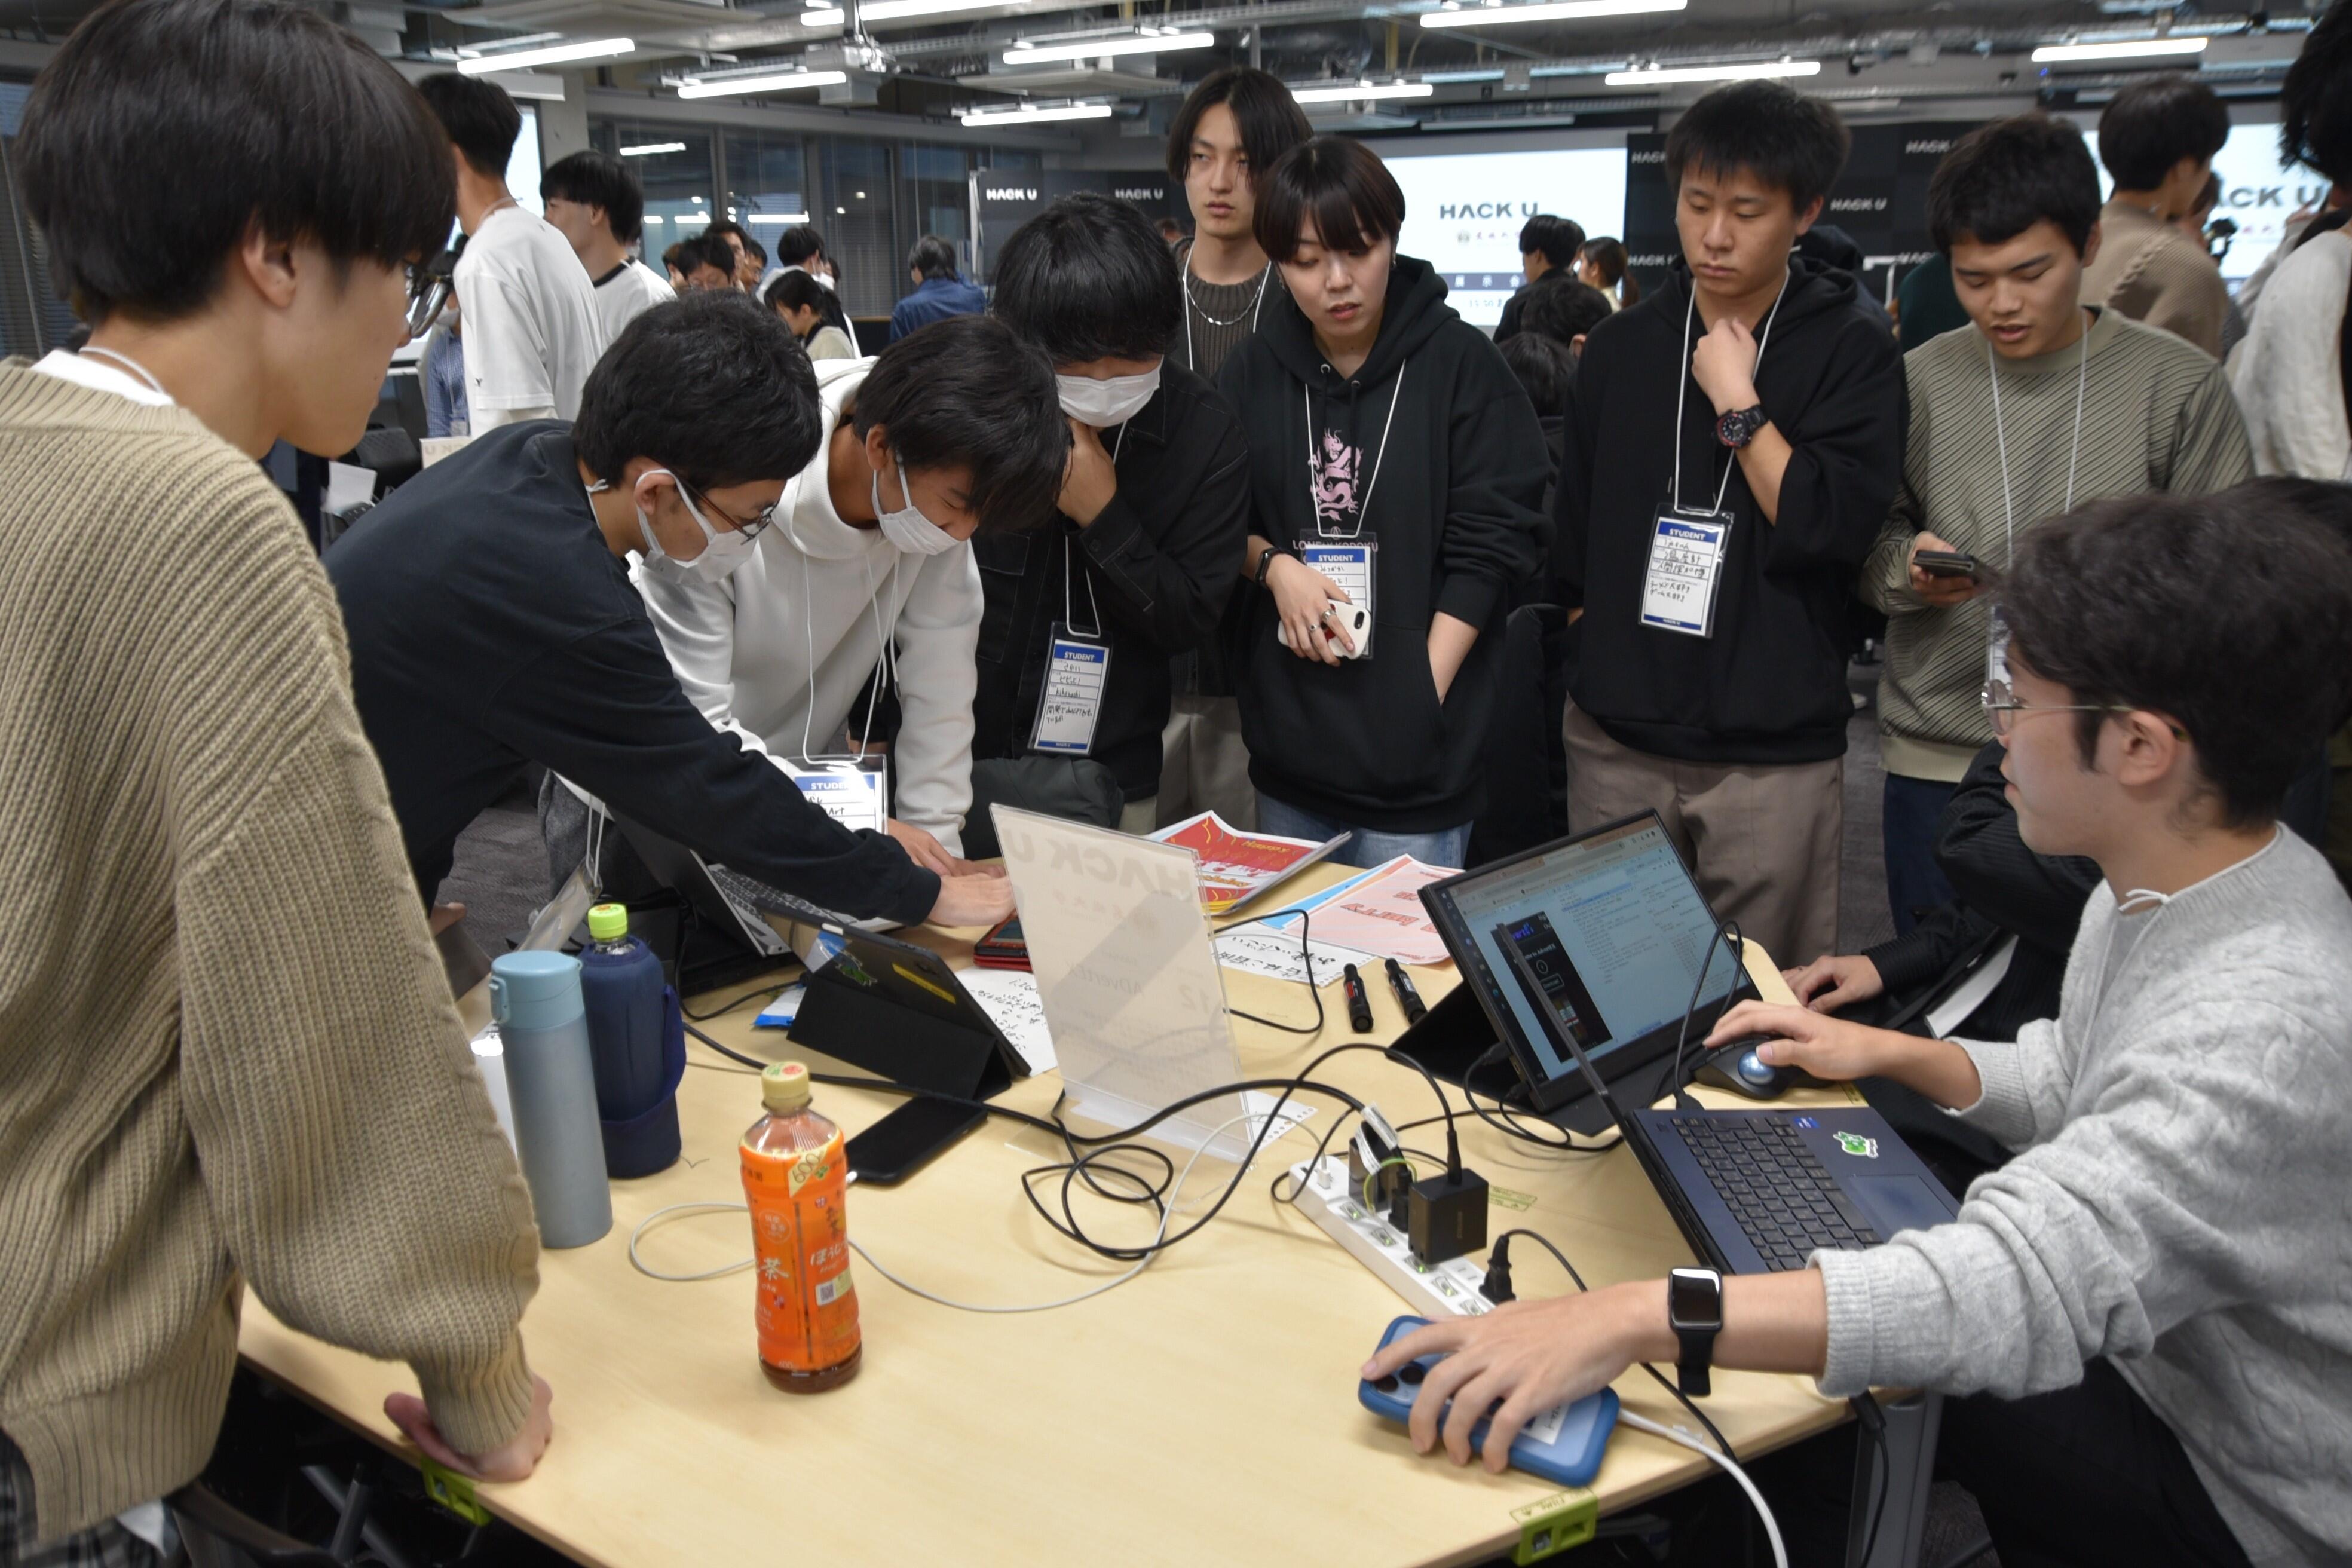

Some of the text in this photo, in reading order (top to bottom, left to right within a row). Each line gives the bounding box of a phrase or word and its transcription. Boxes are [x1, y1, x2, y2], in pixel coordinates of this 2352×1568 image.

[986, 188, 1037, 201] HACK U
[1115, 187, 1163, 200] HACK U
[1440, 201, 1538, 219] HACK U
[1830, 197, 1887, 212] HACK U
[1627, 254, 1666, 267] HACK
[1897, 251, 1933, 265] HAC
[1669, 528, 1706, 540] STUDENT
[1064, 651, 1095, 662] STUDENT
[811, 782, 849, 790] STUDE
[792, 1153, 820, 1183] 600
